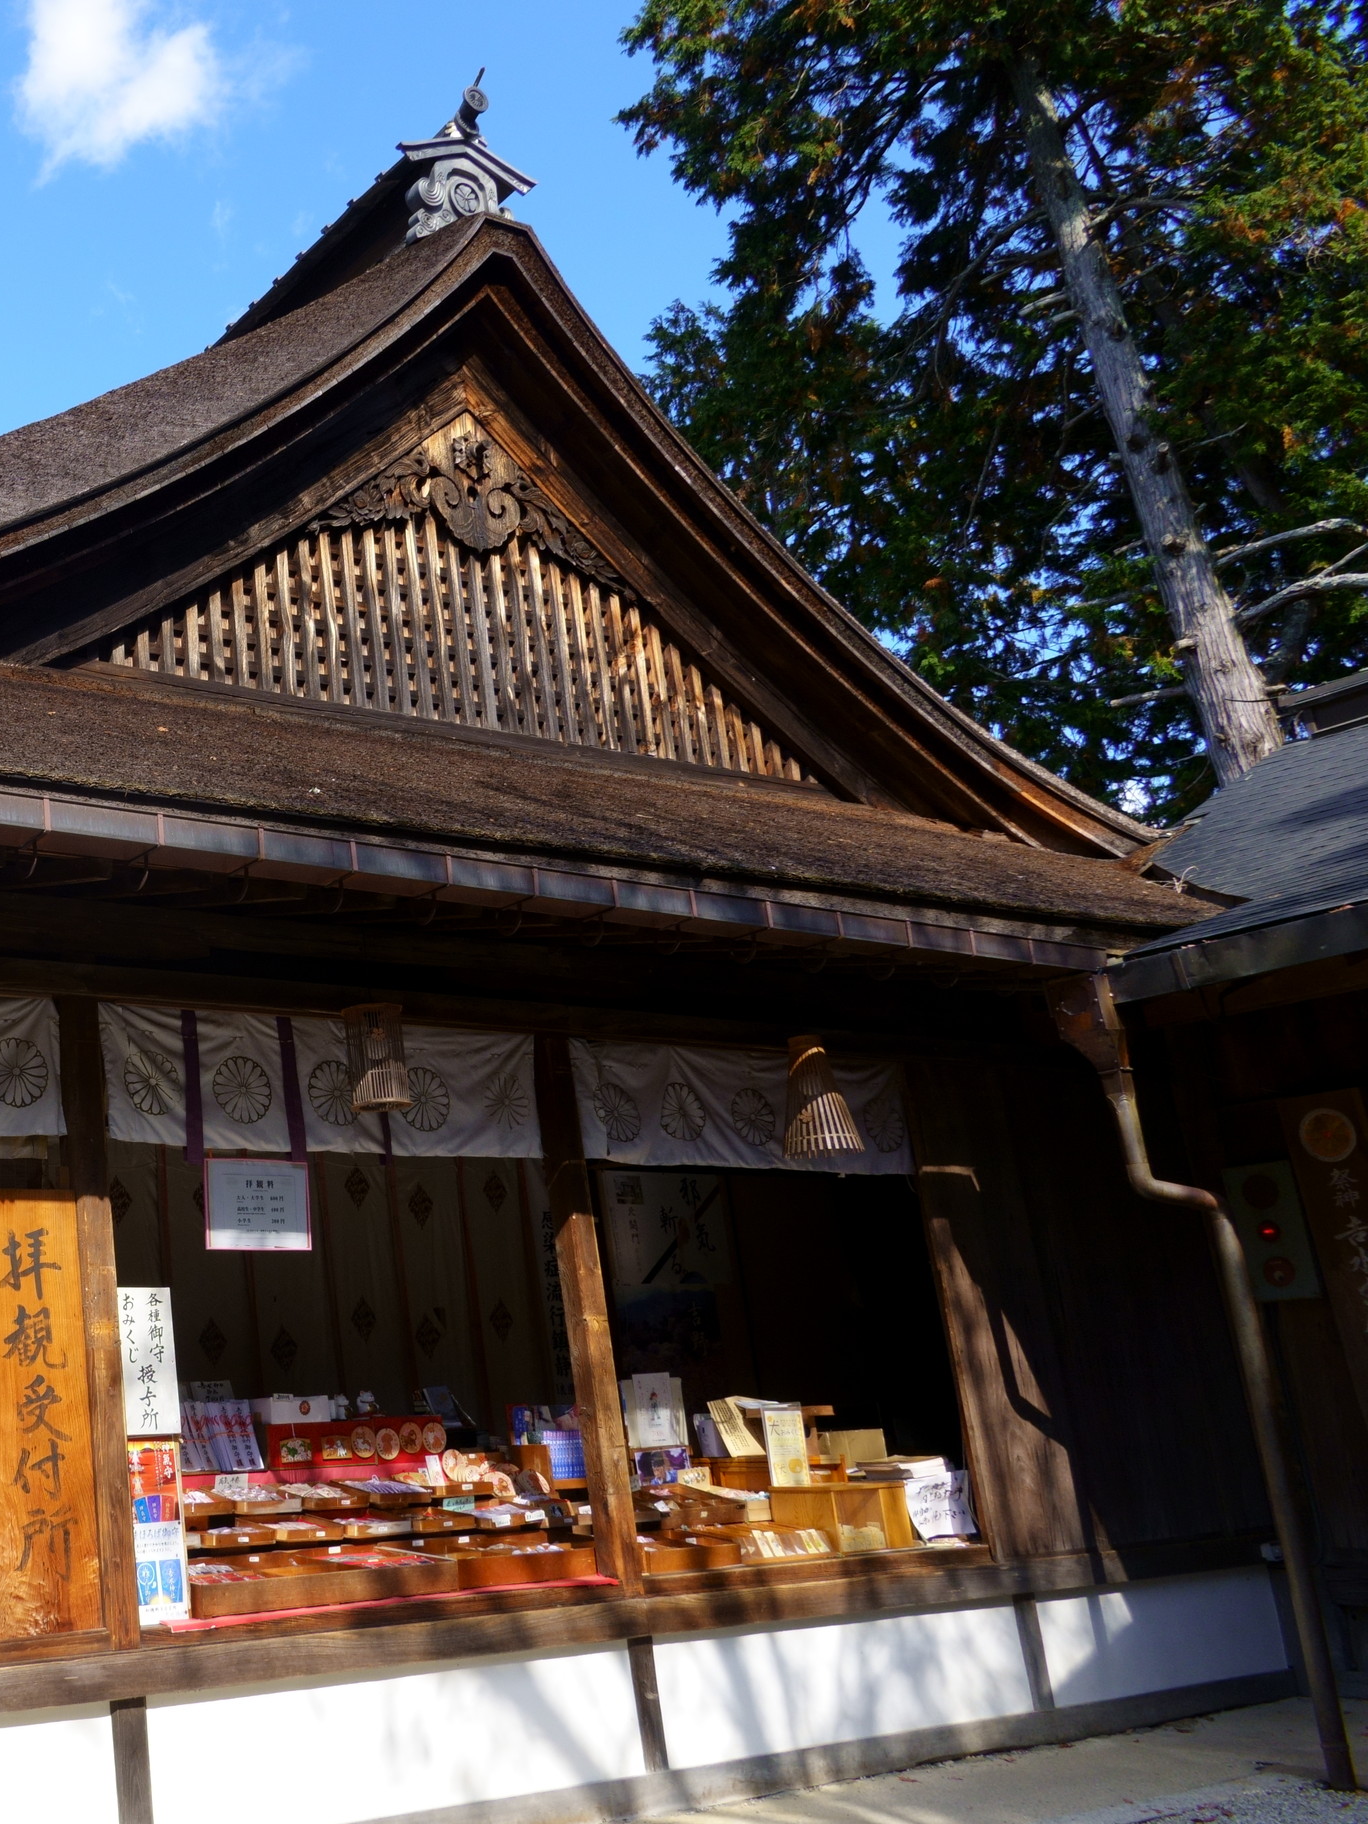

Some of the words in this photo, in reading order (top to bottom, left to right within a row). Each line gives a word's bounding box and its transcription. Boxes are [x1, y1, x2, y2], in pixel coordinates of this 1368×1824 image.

[122, 1293, 139, 1364] おみくじ
[146, 1293, 165, 1364] 各種御守
